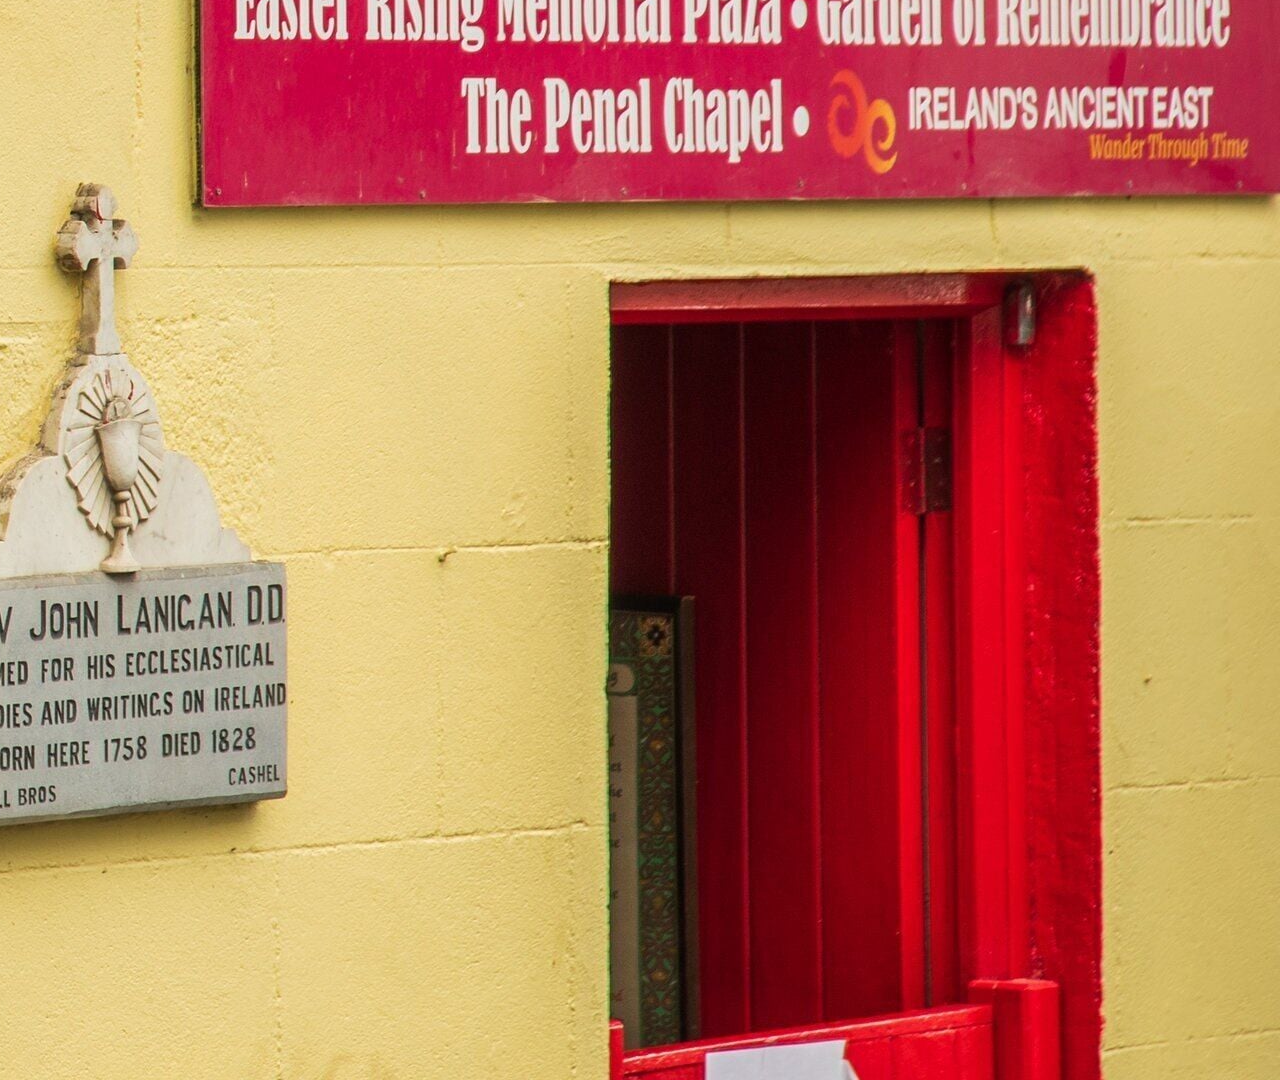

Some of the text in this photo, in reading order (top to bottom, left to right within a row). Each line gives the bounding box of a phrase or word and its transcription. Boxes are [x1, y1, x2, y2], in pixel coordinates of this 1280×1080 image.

[461, 77, 784, 164] The Penal Chapel
[908, 86, 1214, 131] IRELAND'S ANCIENT EAST
[1089, 132, 1249, 168] Wander Through Time
[29, 599, 99, 642] JOHN
[247, 582, 286, 626] D.D.
[41, 657, 74, 684] FOR
[87, 653, 116, 680] HIS
[125, 642, 274, 677] ECCLESIASTICAL
[41, 698, 77, 725] AND
[87, 690, 174, 722] WRITINGS
[182, 689, 205, 714] ON
[214, 682, 287, 711] IRELAND
[47, 740, 90, 768] HERE
[103, 735, 147, 763] 1758
[161, 731, 201, 758] DIED
[211, 726, 256, 754] 1828
[18, 785, 57, 807] BROS
[228, 764, 280, 786] CASHEL
